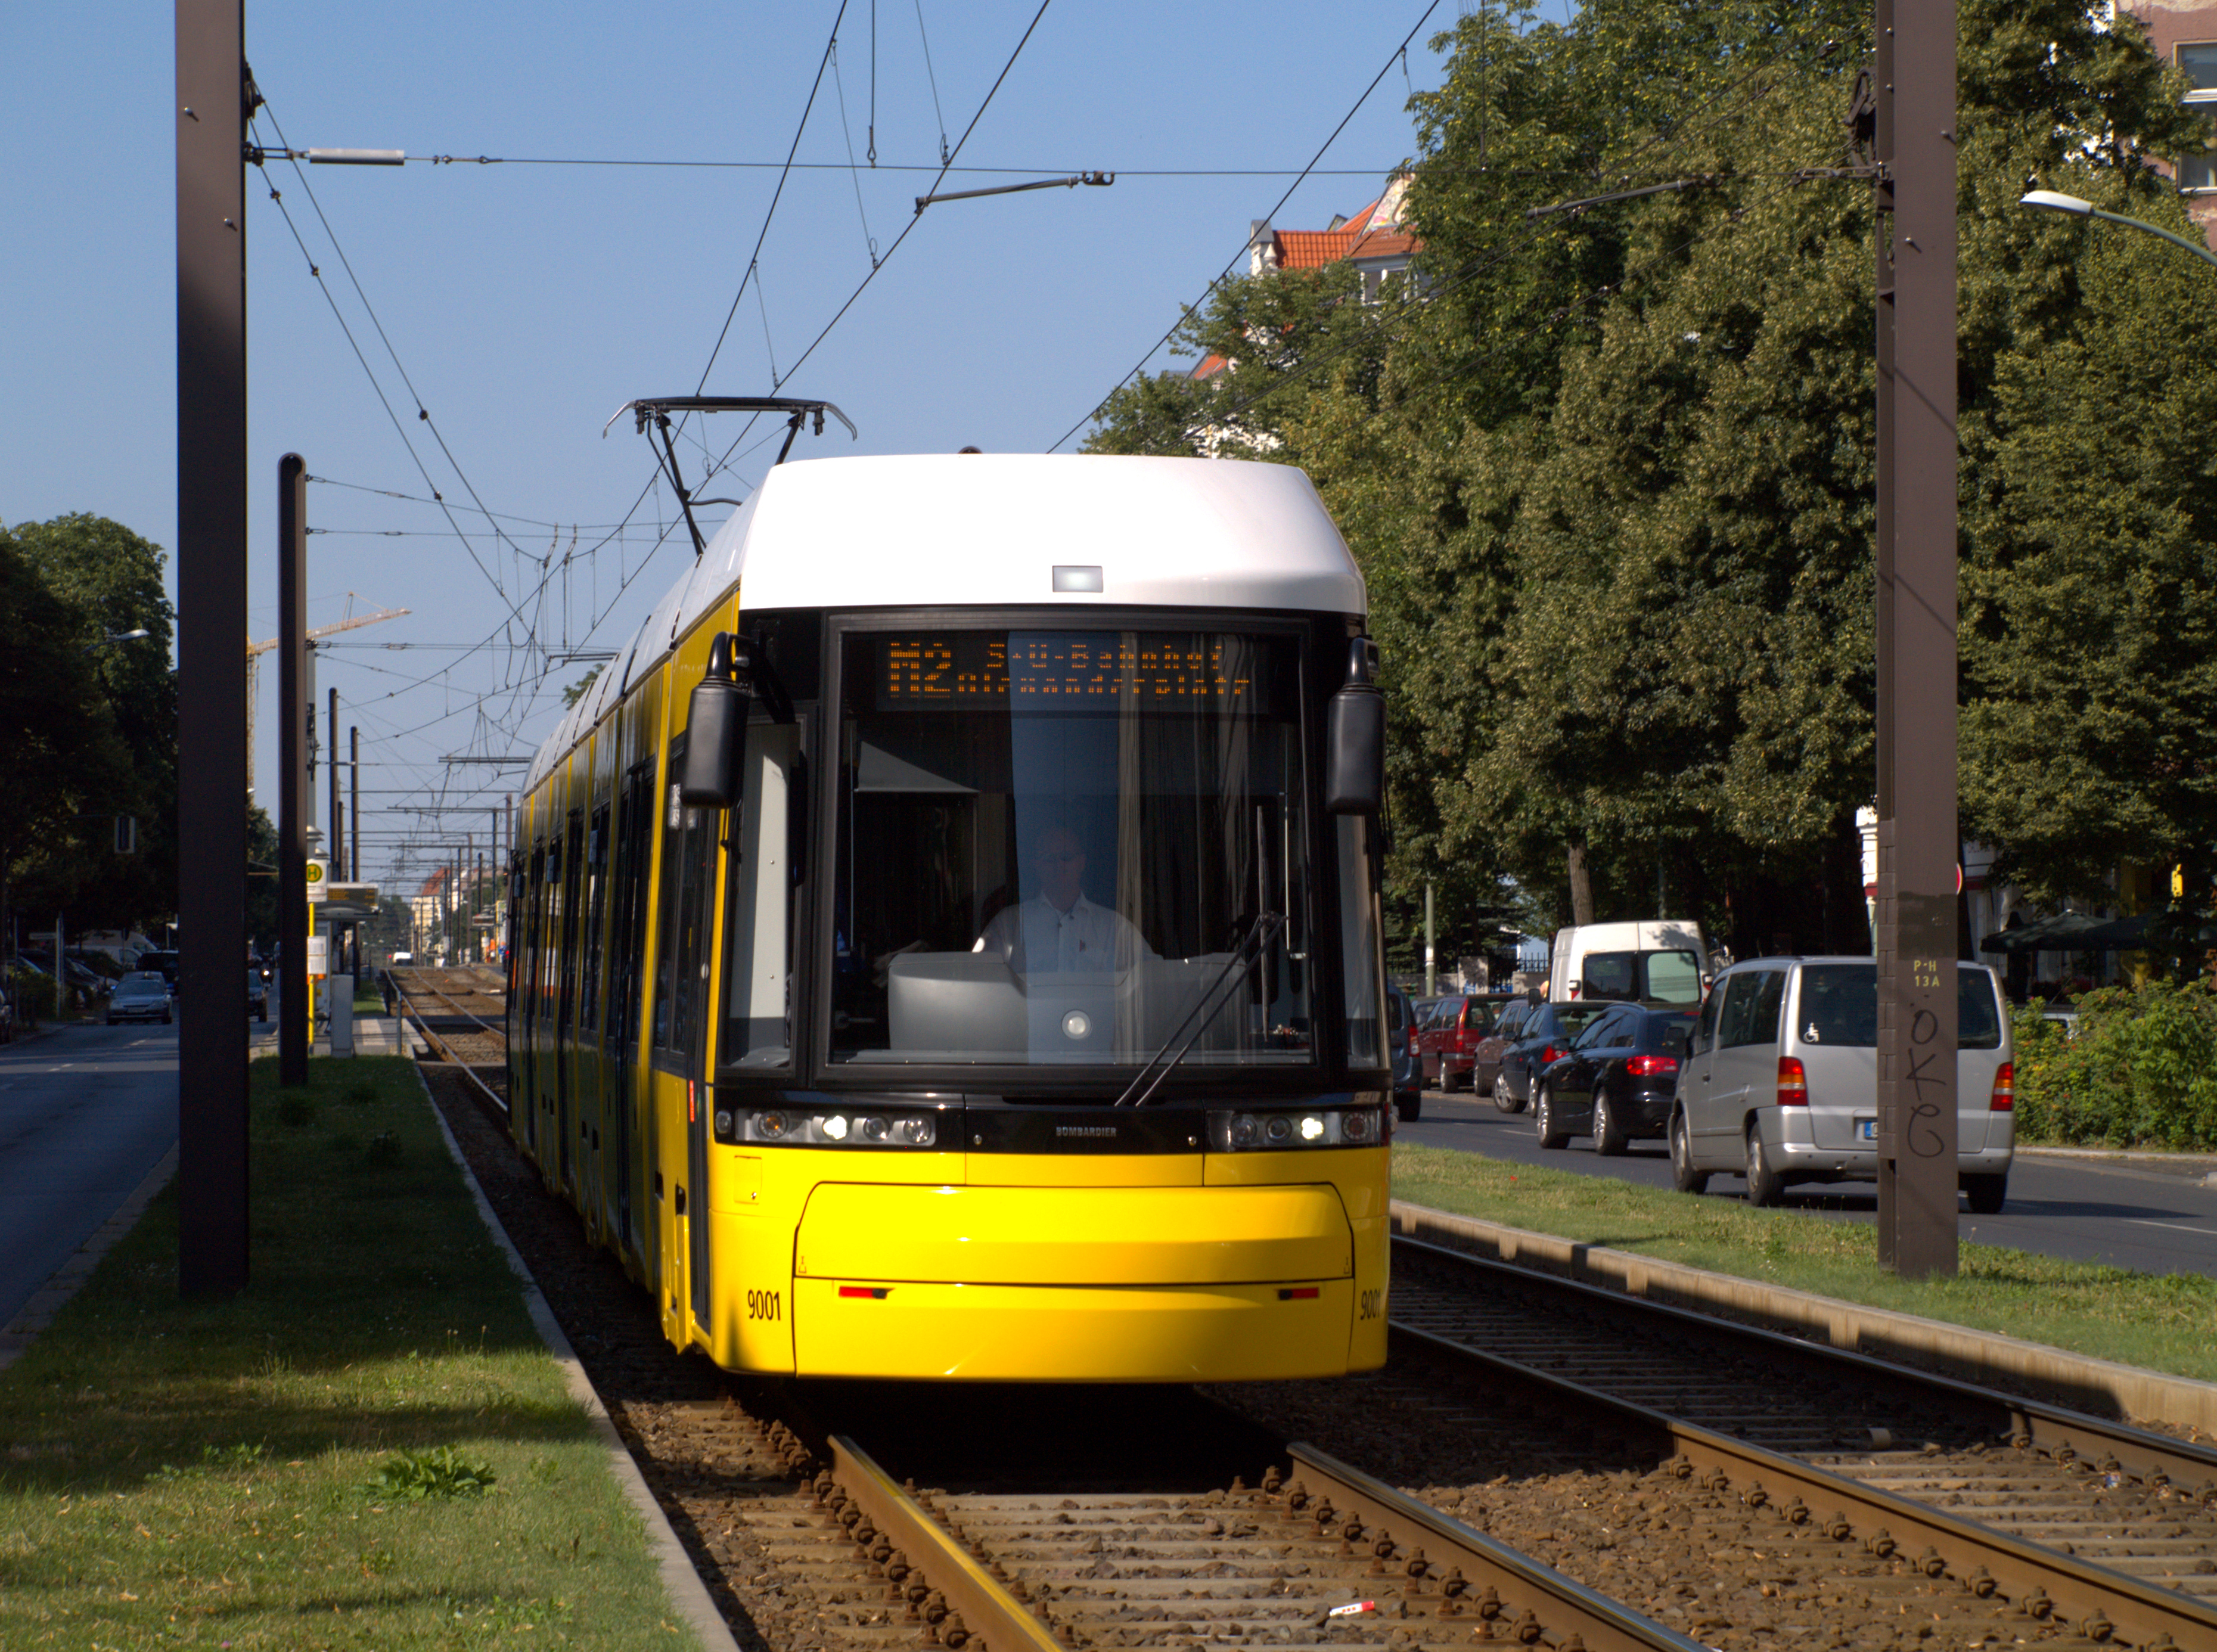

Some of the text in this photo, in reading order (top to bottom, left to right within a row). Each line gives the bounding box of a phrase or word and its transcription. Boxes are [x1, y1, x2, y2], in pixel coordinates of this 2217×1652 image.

[890, 642, 951, 697] M2
[308, 868, 317, 879] H
[1913, 959, 1937, 972] P-H
[1914, 975, 1940, 988] 13A
[1055, 1126, 1117, 1138] BOMBARDIER
[747, 1290, 781, 1321] 9001
[1359, 1290, 1381, 1321] 9001
